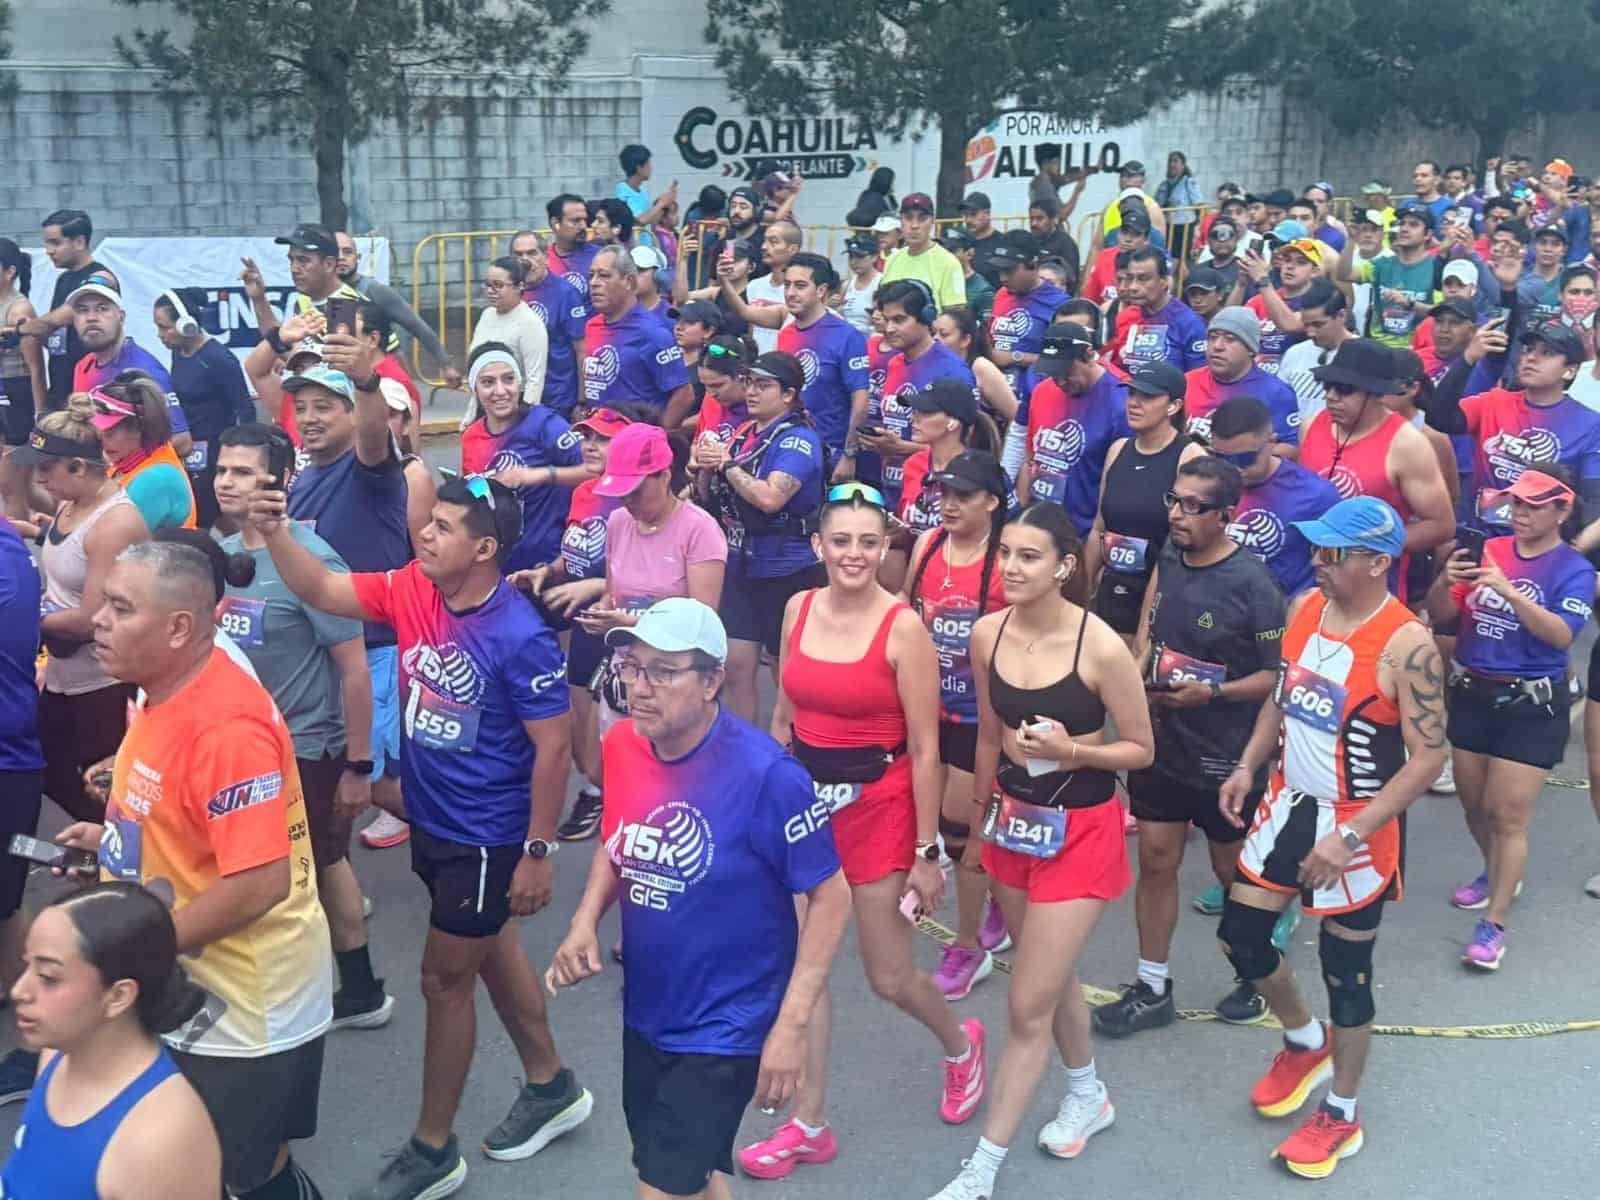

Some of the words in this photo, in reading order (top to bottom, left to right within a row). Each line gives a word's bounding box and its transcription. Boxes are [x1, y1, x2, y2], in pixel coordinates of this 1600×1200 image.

[674, 106, 877, 169] COAHUILA
[1006, 115, 1041, 136] POR
[656, 345, 681, 365] GIS
[780, 435, 813, 456] GIS
[1499, 433, 1535, 461] 15K
[1110, 546, 1137, 565] 676
[222, 612, 251, 636] 933
[933, 617, 972, 638] 605
[1476, 622, 1506, 640] GIS
[1290, 685, 1334, 717] 606
[415, 708, 462, 740] 559
[784, 800, 830, 844] GIS
[1007, 816, 1054, 846] 1341
[623, 822, 679, 868] 15K
[630, 883, 669, 912] GIS
